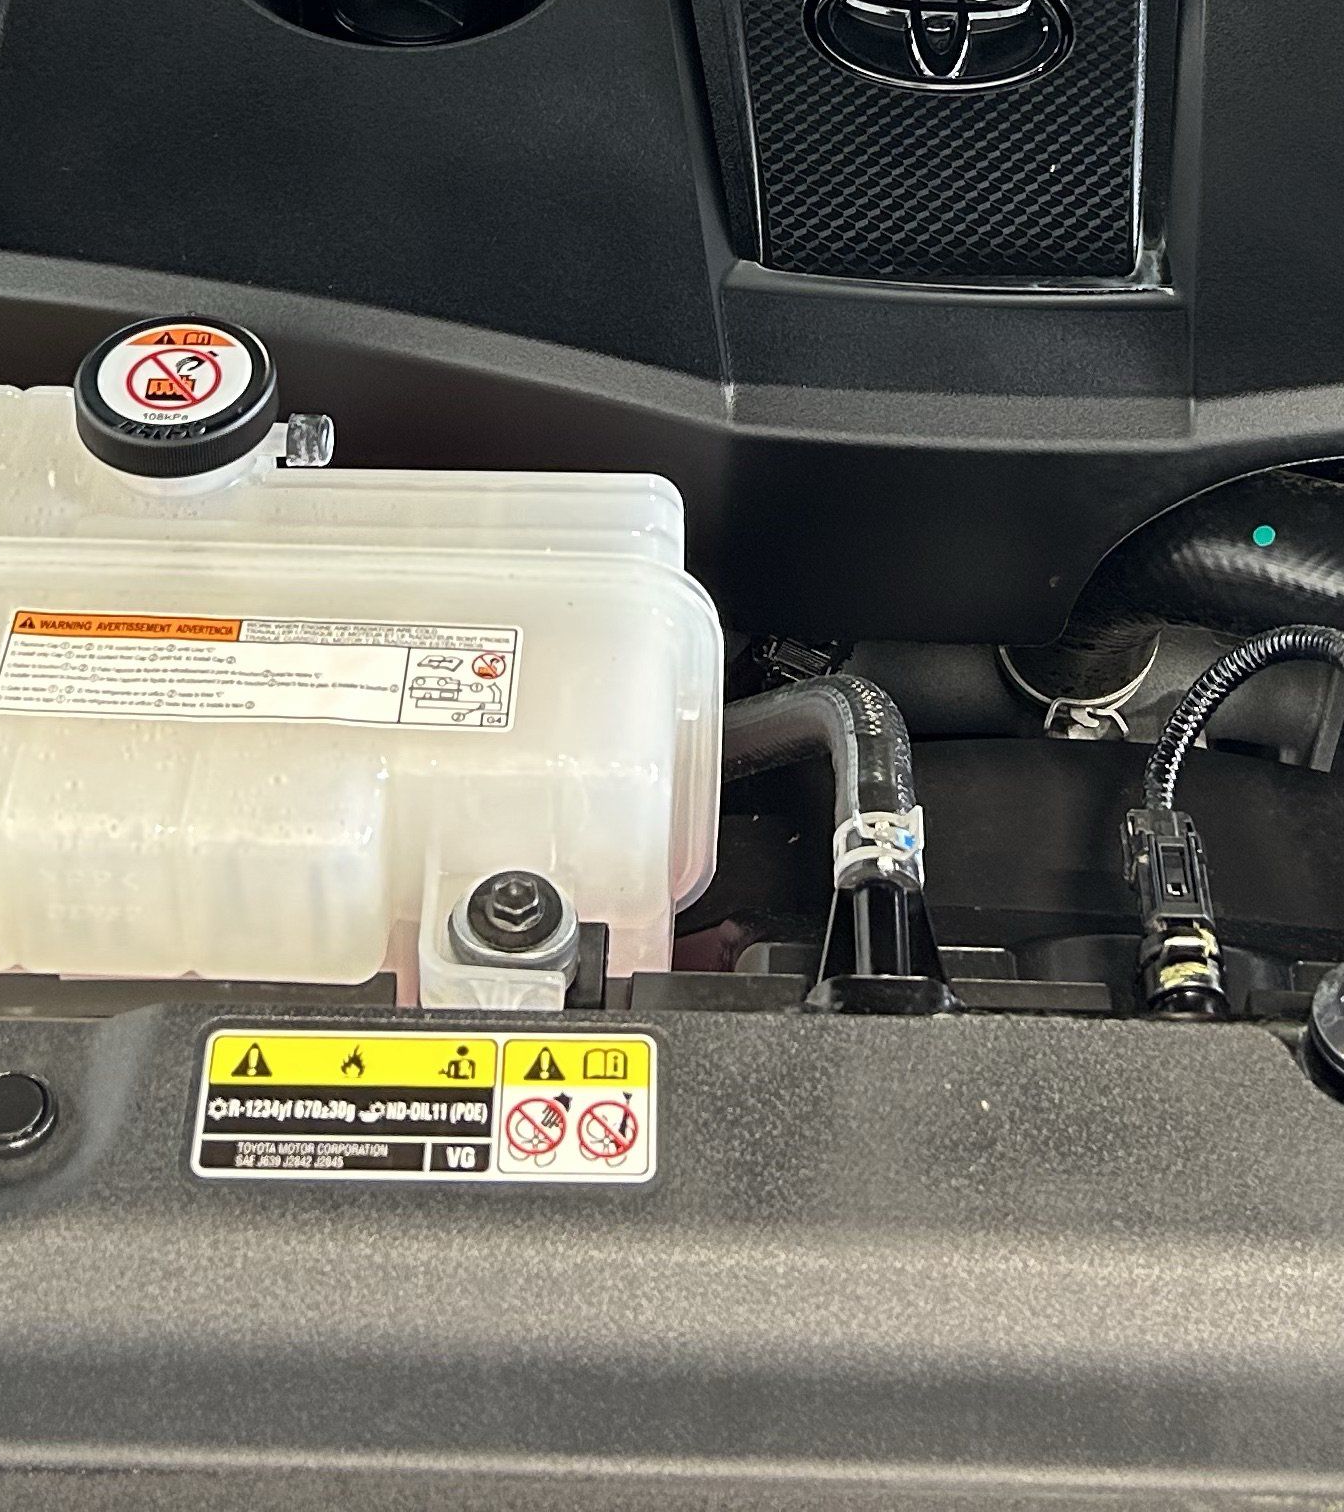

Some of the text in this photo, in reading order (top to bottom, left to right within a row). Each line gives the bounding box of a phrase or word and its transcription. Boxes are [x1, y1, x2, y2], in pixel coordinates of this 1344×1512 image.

[143, 413, 190, 422] 108kPa
[39, 619, 92, 631] WARNING
[95, 621, 172, 634] AVERTISSEMENT
[175, 623, 234, 636] ADVERTENCIA
[228, 1098, 293, 1122] R-1234yf
[449, 1101, 488, 1124] (POE)
[235, 1141, 389, 1158] TOYOTA MOTOR CORPORATION
[445, 1146, 477, 1169] VG
[234, 1154, 255, 1168] SAE
